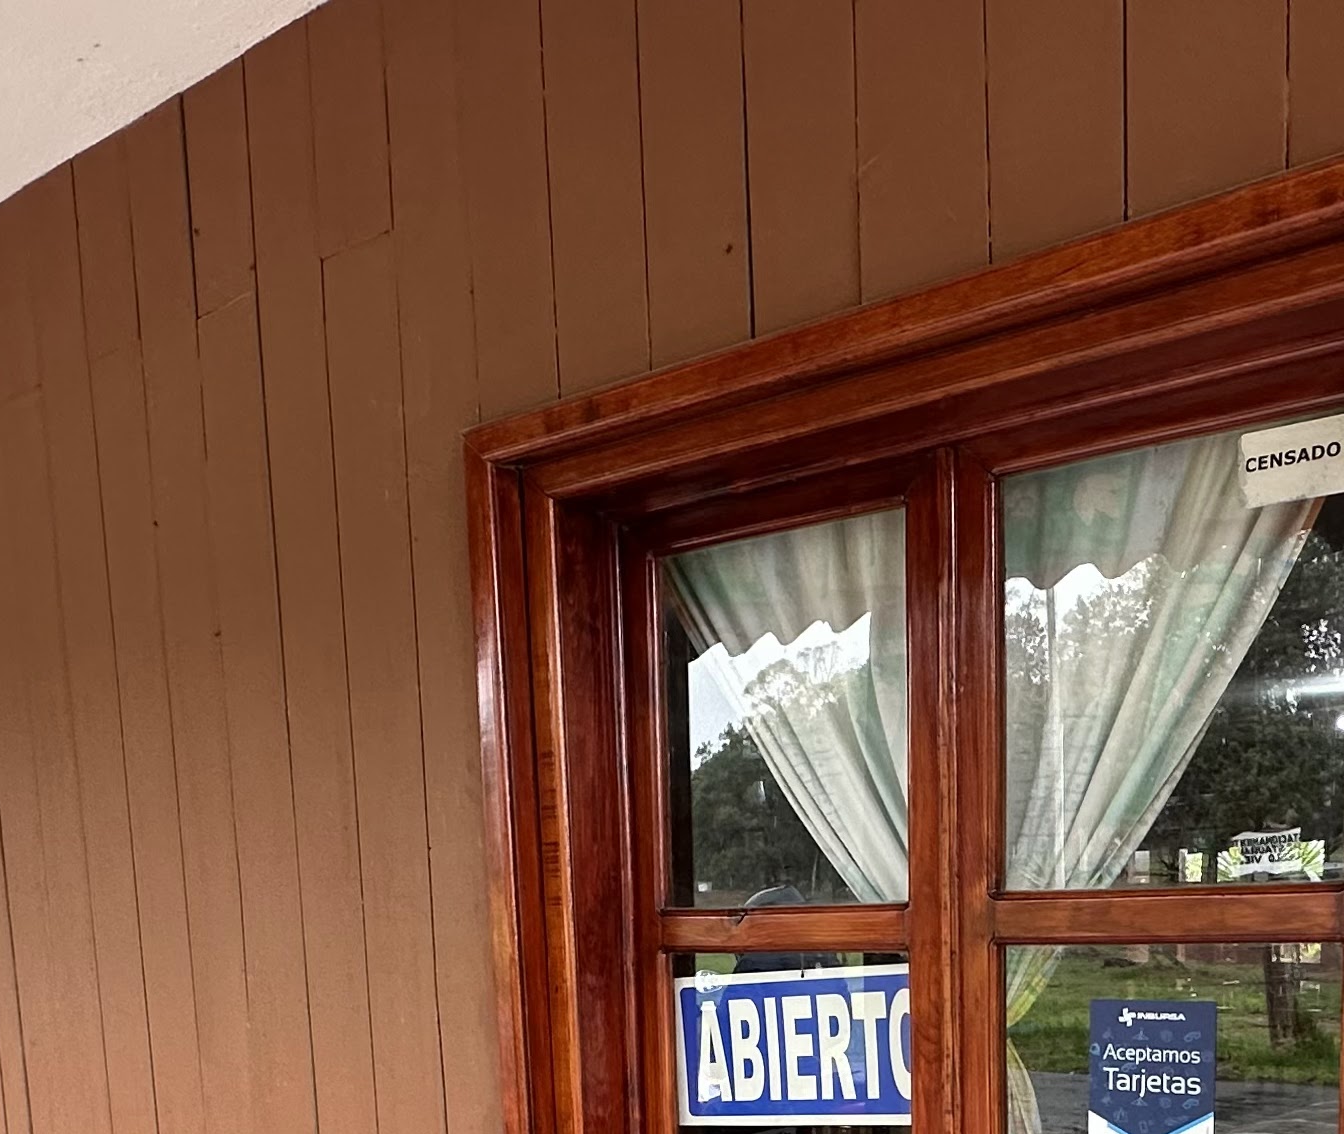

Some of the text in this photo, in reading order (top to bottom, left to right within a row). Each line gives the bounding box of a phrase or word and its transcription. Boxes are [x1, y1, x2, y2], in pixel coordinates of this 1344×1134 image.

[1245, 441, 1342, 473] CENSADO
[1136, 1012, 1186, 1021] INBURSA
[697, 988, 912, 1102] ABIERTO
[1102, 1043, 1201, 1065] Aceptamos
[1102, 1066, 1202, 1097] Tarjetas
